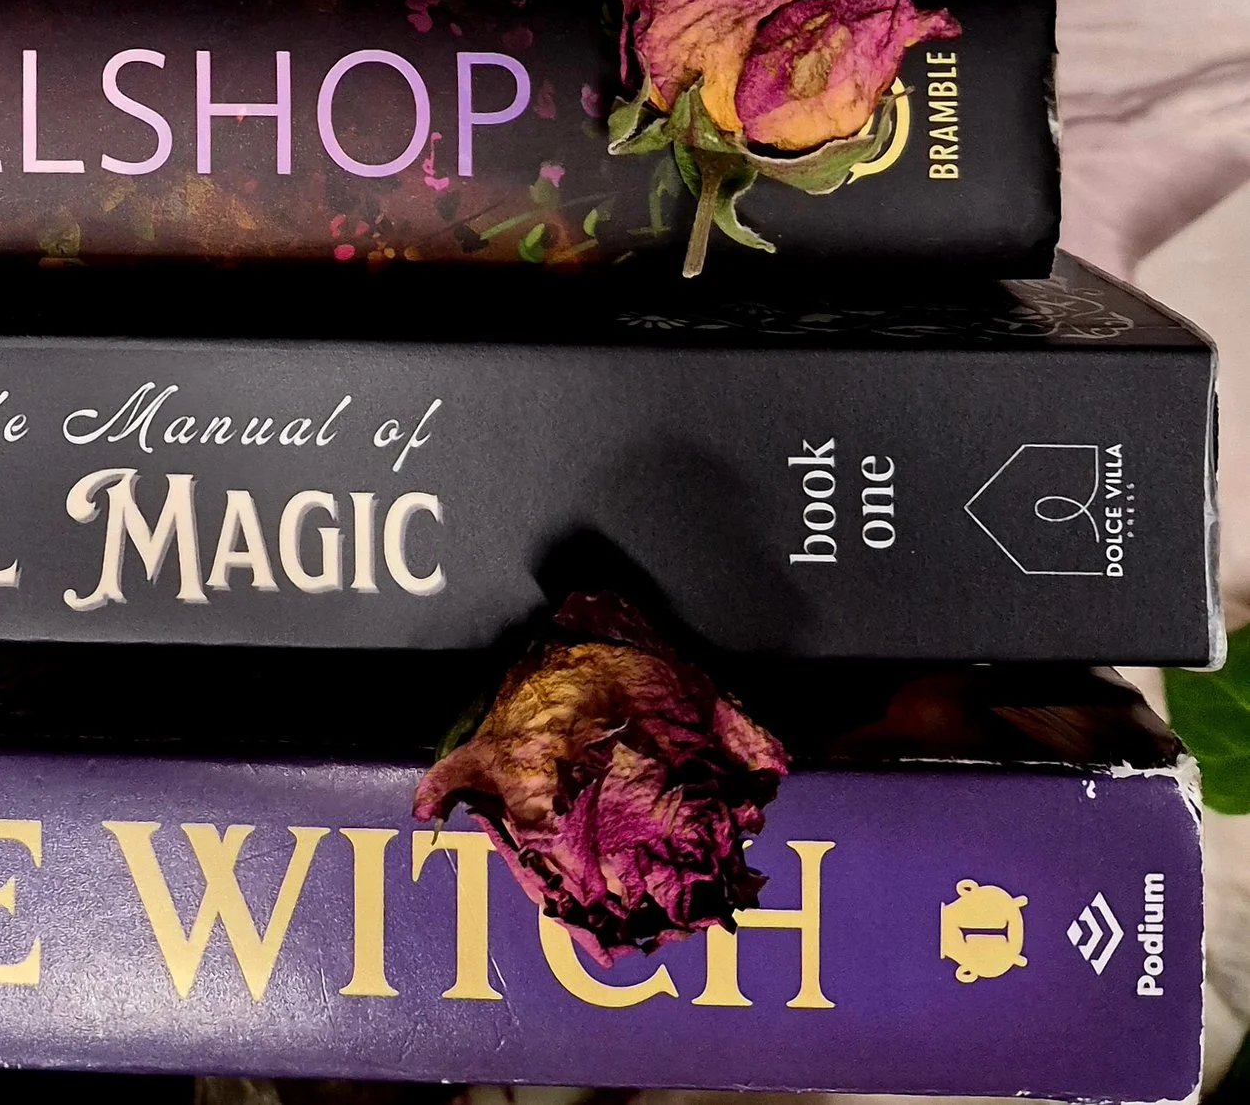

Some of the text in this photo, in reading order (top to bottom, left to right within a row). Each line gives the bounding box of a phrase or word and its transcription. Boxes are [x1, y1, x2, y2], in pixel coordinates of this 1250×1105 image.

[926, 51, 959, 180] BRAMBLE
[63, 381, 352, 453] Manual
[373, 398, 443, 472] of
[63, 467, 448, 612] MAGIC
[788, 437, 838, 566] book
[860, 454, 897, 549] one
[1105, 444, 1124, 577] DOLCE VILLA
[1137, 873, 1165, 996] Podium
